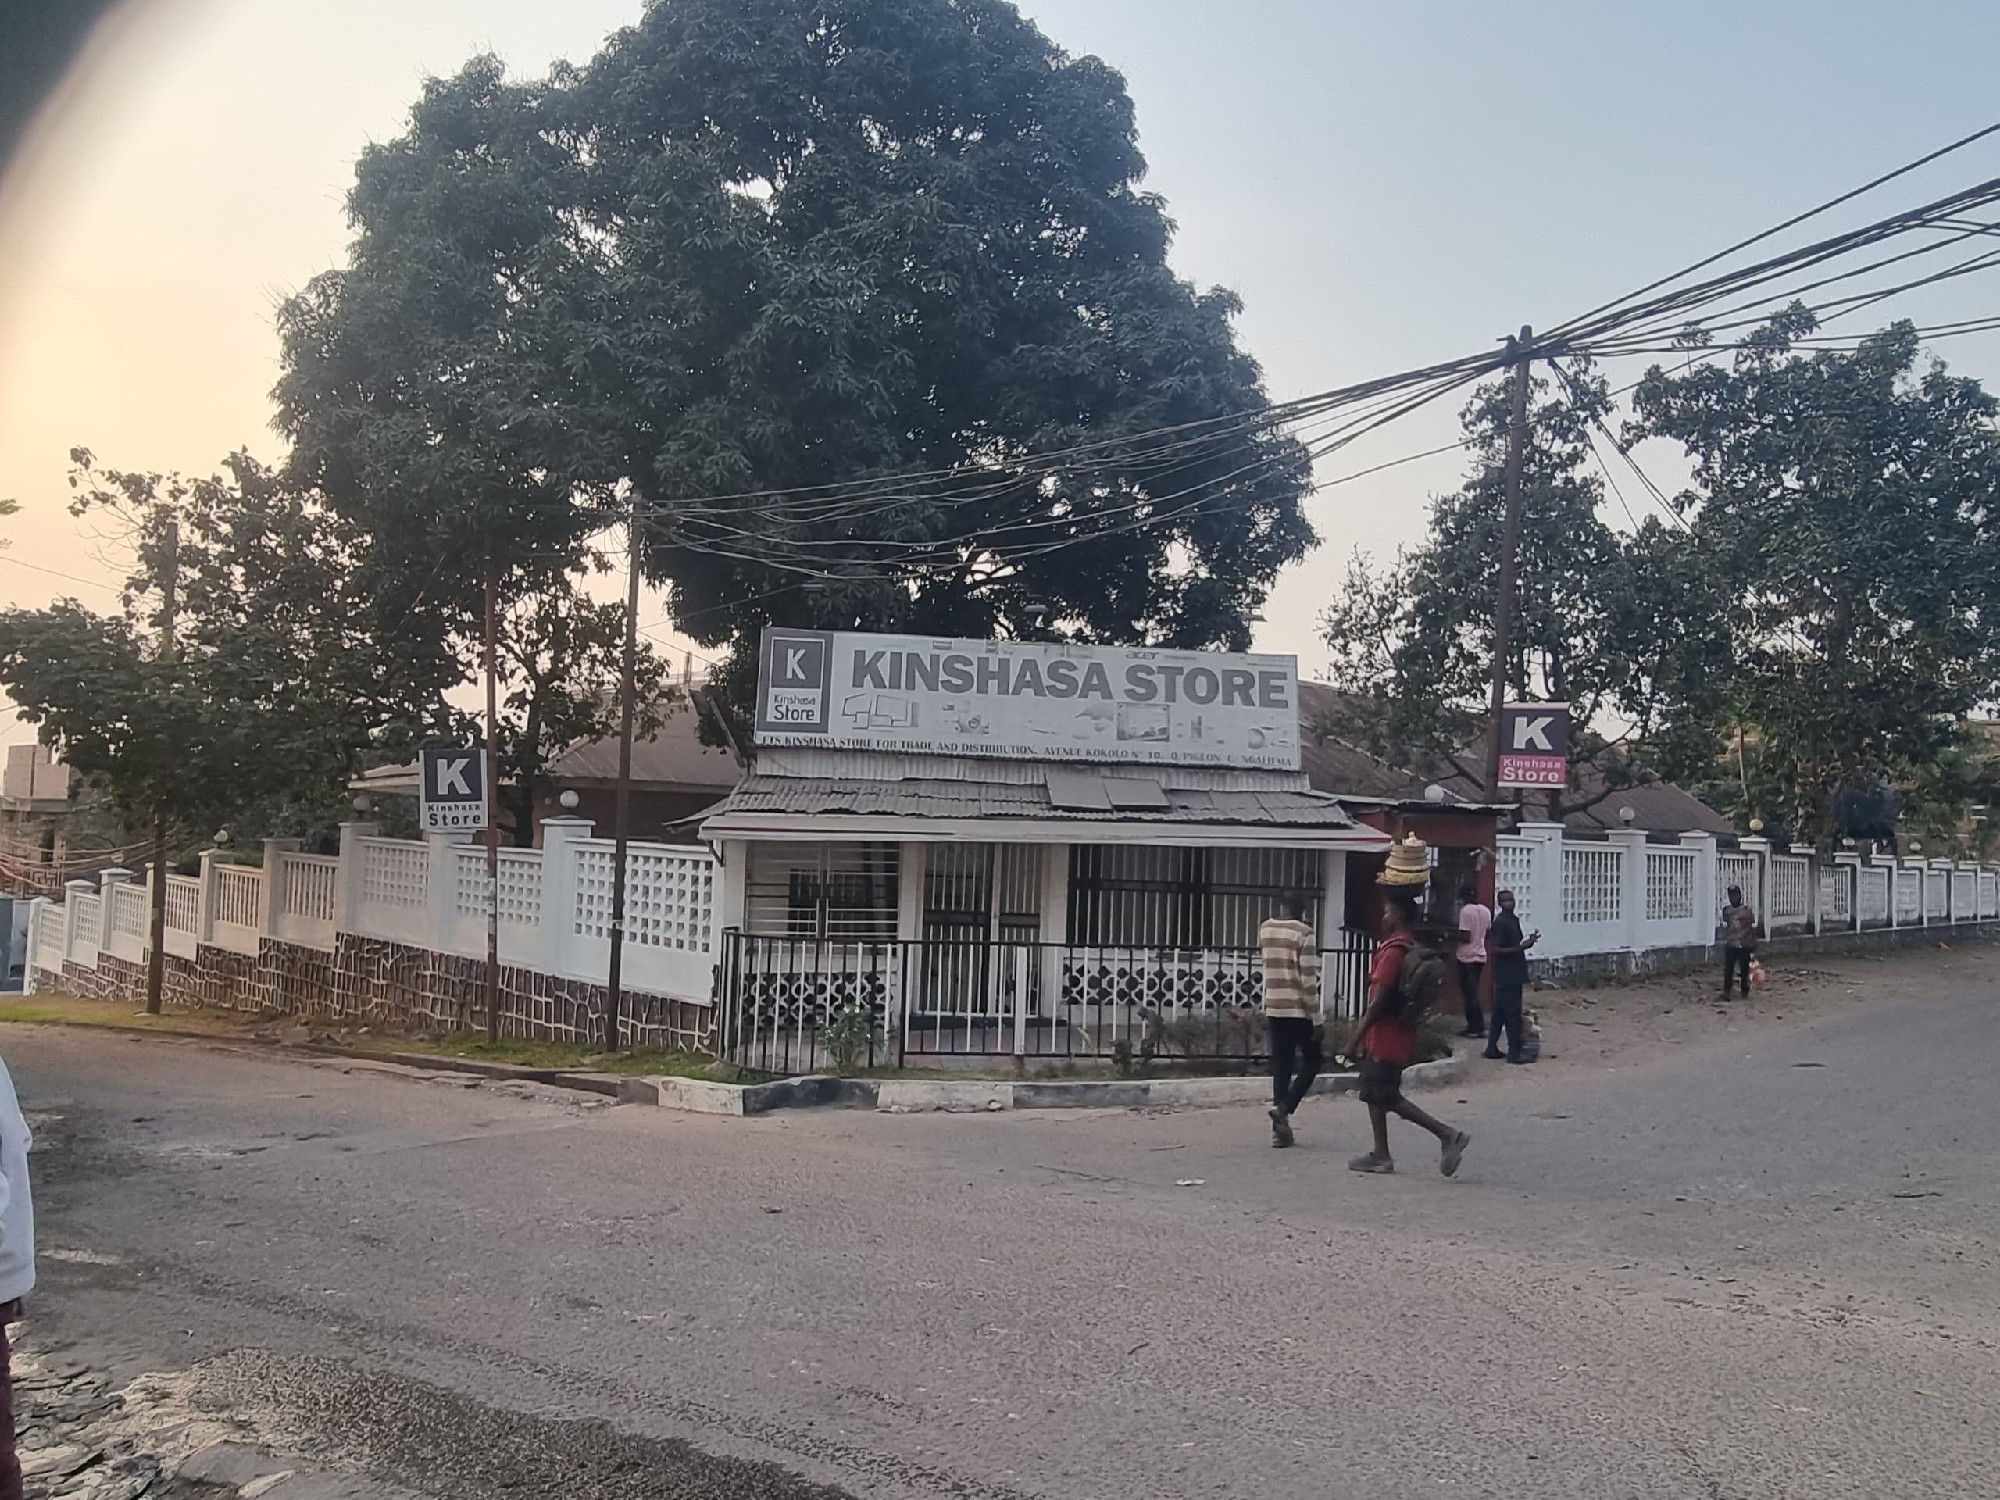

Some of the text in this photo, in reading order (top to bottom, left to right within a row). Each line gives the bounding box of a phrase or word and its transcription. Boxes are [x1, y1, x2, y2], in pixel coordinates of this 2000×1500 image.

[786, 648, 806, 680] K
[852, 649, 1289, 709] KINSHASA STORE
[773, 704, 815, 721] Store
[1513, 716, 1554, 750] K
[938, 741, 959, 752] AND
[437, 758, 472, 795] K
[1503, 766, 1559, 783] Store
[429, 812, 481, 827] Store
